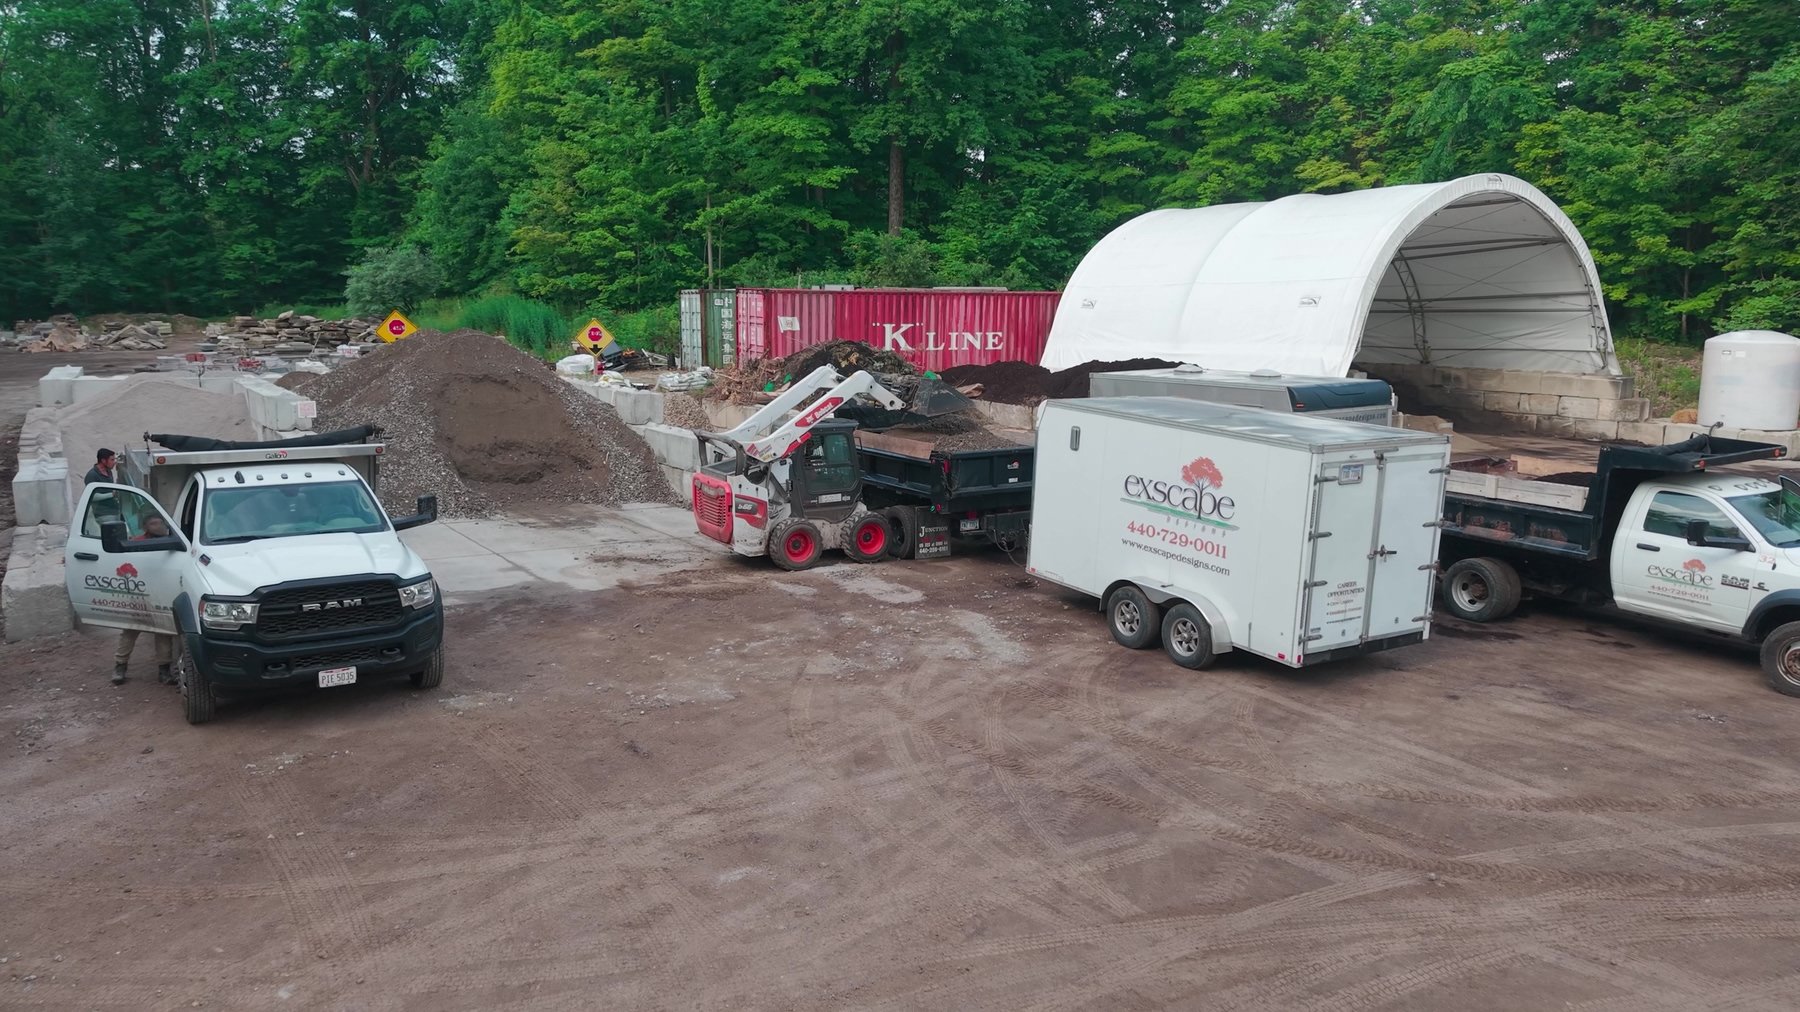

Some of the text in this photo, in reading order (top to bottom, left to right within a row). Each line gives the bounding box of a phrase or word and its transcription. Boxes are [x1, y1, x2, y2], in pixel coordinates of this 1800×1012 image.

[926, 331, 1003, 351] LINE
[1124, 474, 1236, 520] exscape
[1121, 537, 1231, 577] www.exscapedesigns.com
[85, 574, 146, 593] exscape
[1648, 564, 1712, 586] exscape
[302, 598, 362, 612] RAM
